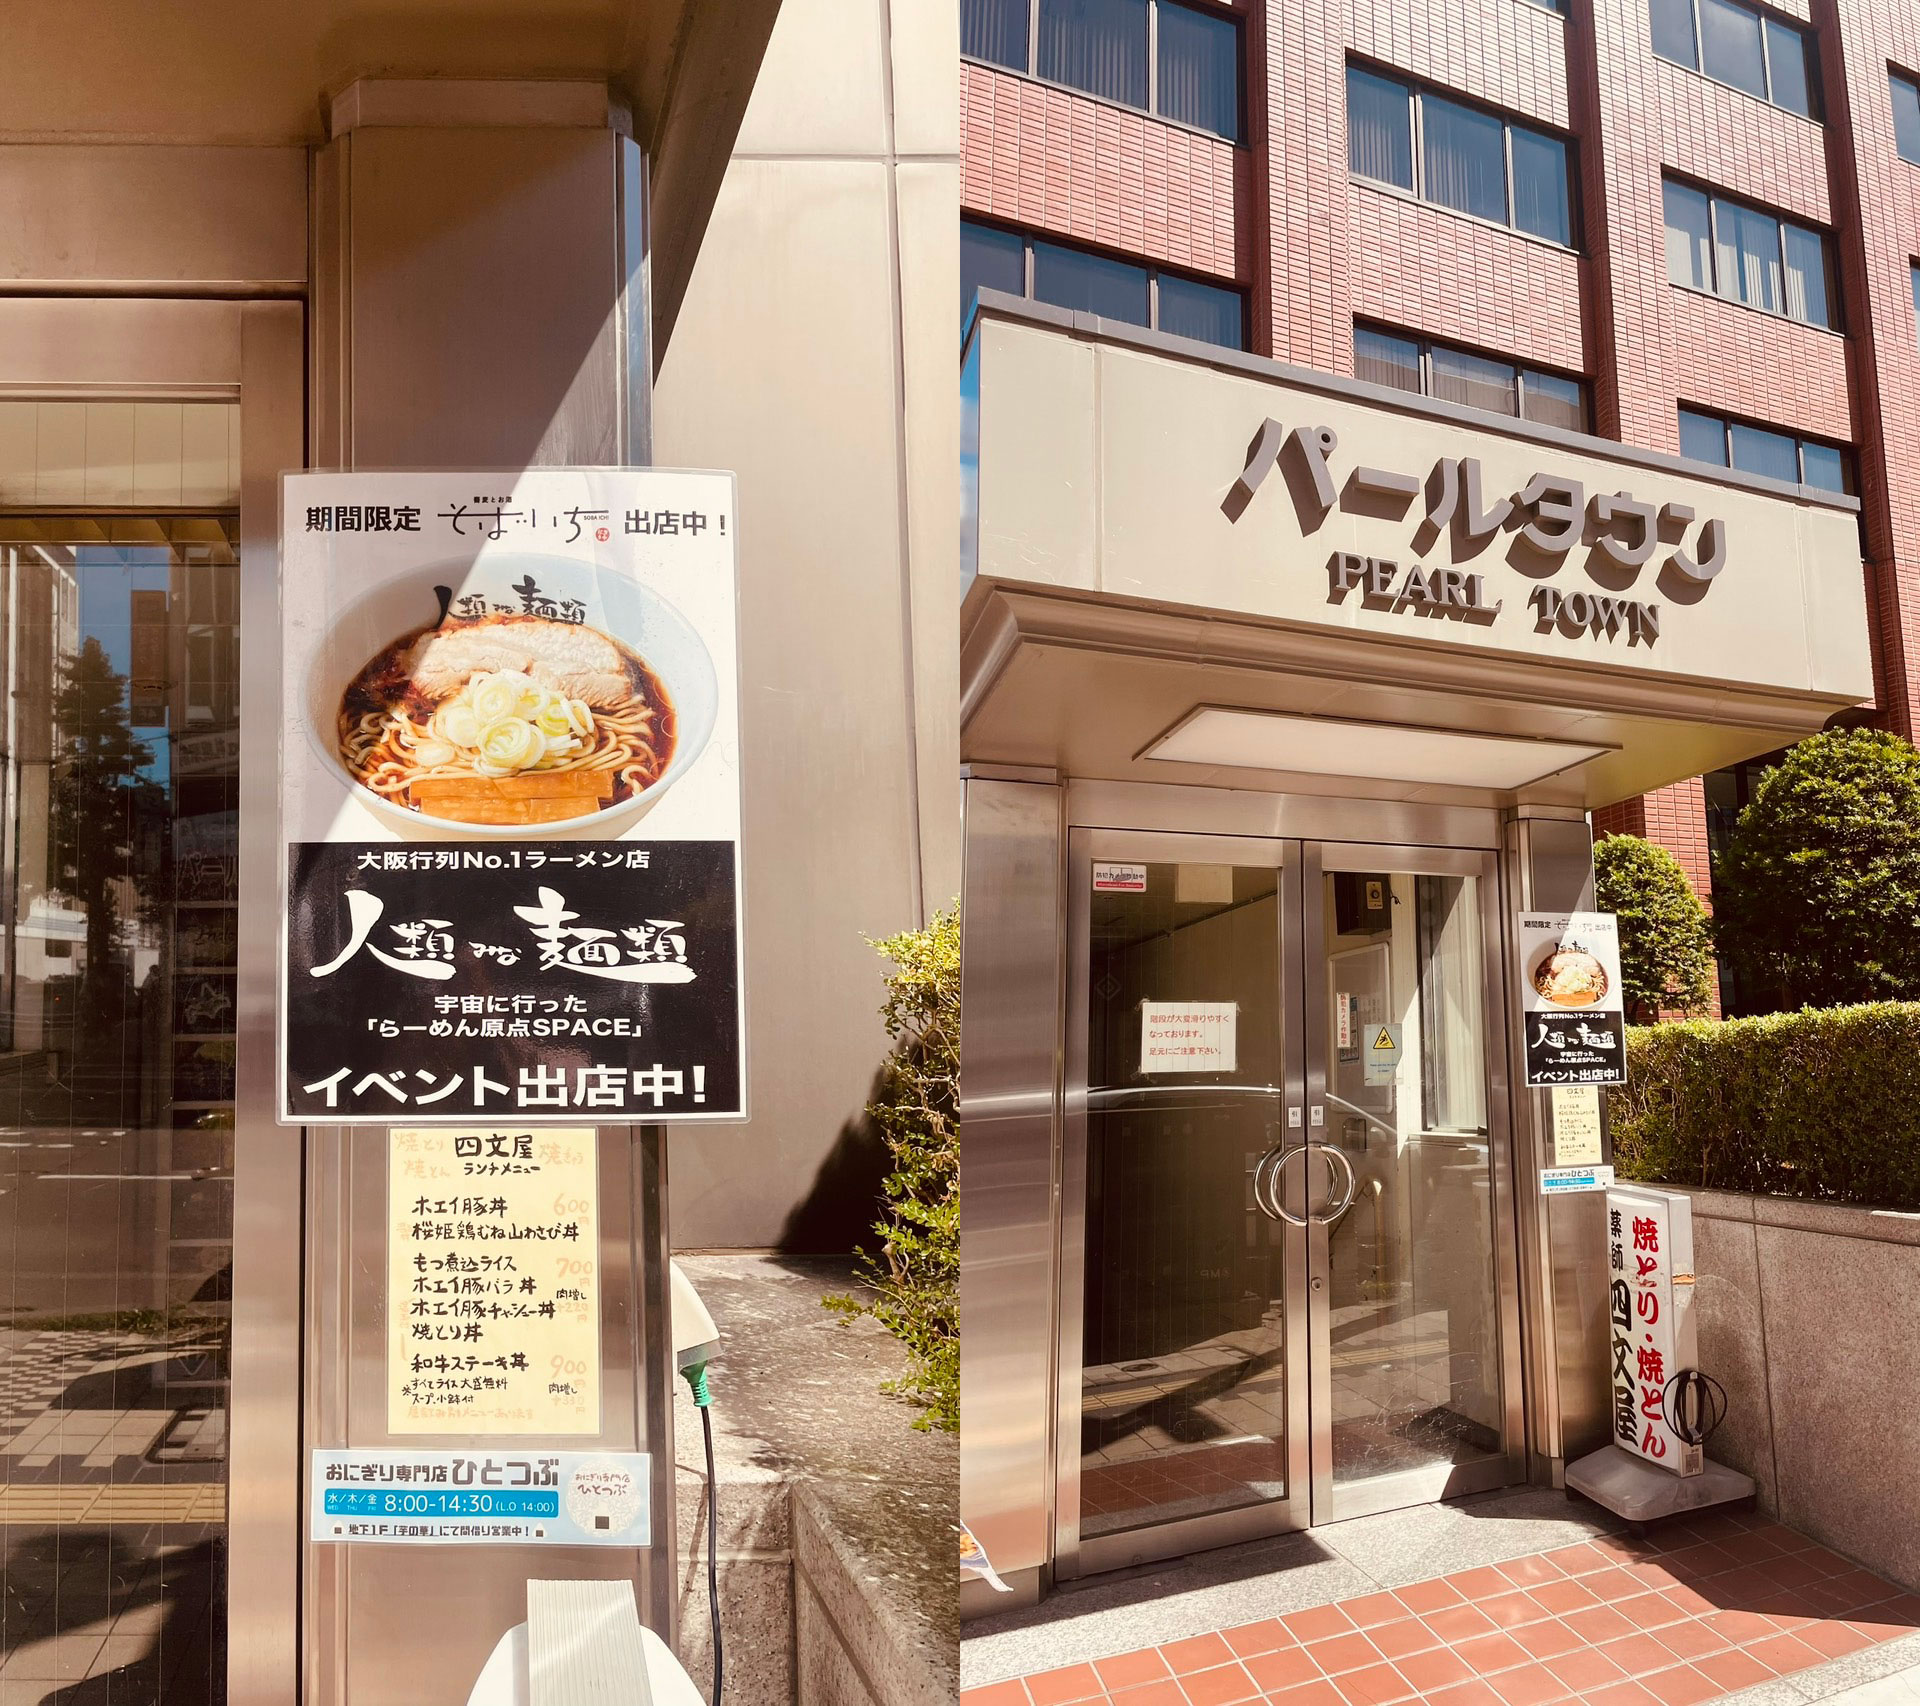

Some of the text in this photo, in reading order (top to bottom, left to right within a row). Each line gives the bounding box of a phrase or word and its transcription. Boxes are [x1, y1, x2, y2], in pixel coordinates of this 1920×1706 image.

[1222, 417, 1726, 600] パールタウン
[306, 505, 421, 532] 期間限定
[624, 509, 727, 537] 出店中！
[1328, 550, 1660, 645] PEARL TOWN
[357, 850, 650, 871] 大阪行列No.1ラーメン店
[310, 885, 698, 984] 人類みな麺類
[434, 994, 588, 1014] 宇宙に行った
[367, 1017, 642, 1038] 「らーめん原点SPACE」
[1150, 1014, 1229, 1024] 階段が大変滑りやすく
[1149, 1030, 1202, 1038] なっております。
[1149, 1047, 1221, 1056] 足元にご注意下さい。
[303, 1063, 706, 1108] イベント出店中!
[1531, 1068, 1620, 1082] イベント出店中!
[454, 1133, 534, 1159] 四文屋
[463, 1162, 541, 1176] ランチメニュー
[412, 1195, 508, 1219] ホエイ豚丼
[553, 1192, 589, 1216] 600
[411, 1221, 580, 1242] 桜姫鶏むね山わさび丼
[413, 1251, 517, 1273] もつ煮込ライス
[556, 1257, 593, 1279] 700
[412, 1276, 537, 1295] ホエイ豚バラ丼
[556, 1288, 588, 1300] 肉増し
[412, 1321, 484, 1343] 焼とり丼
[410, 1351, 530, 1374] 和牛ステーキ丼
[550, 1355, 587, 1378] 900
[1610, 1278, 1638, 1447] 四文屋
[549, 1383, 578, 1394] 肉増し
[326, 1459, 559, 1486] おにぎり専門店 ひとつぶ
[577, 1484, 628, 1496] ひとつぶ
[384, 1494, 493, 1513] 8:00-14:30
[522, 1502, 555, 1514] 14:00)
